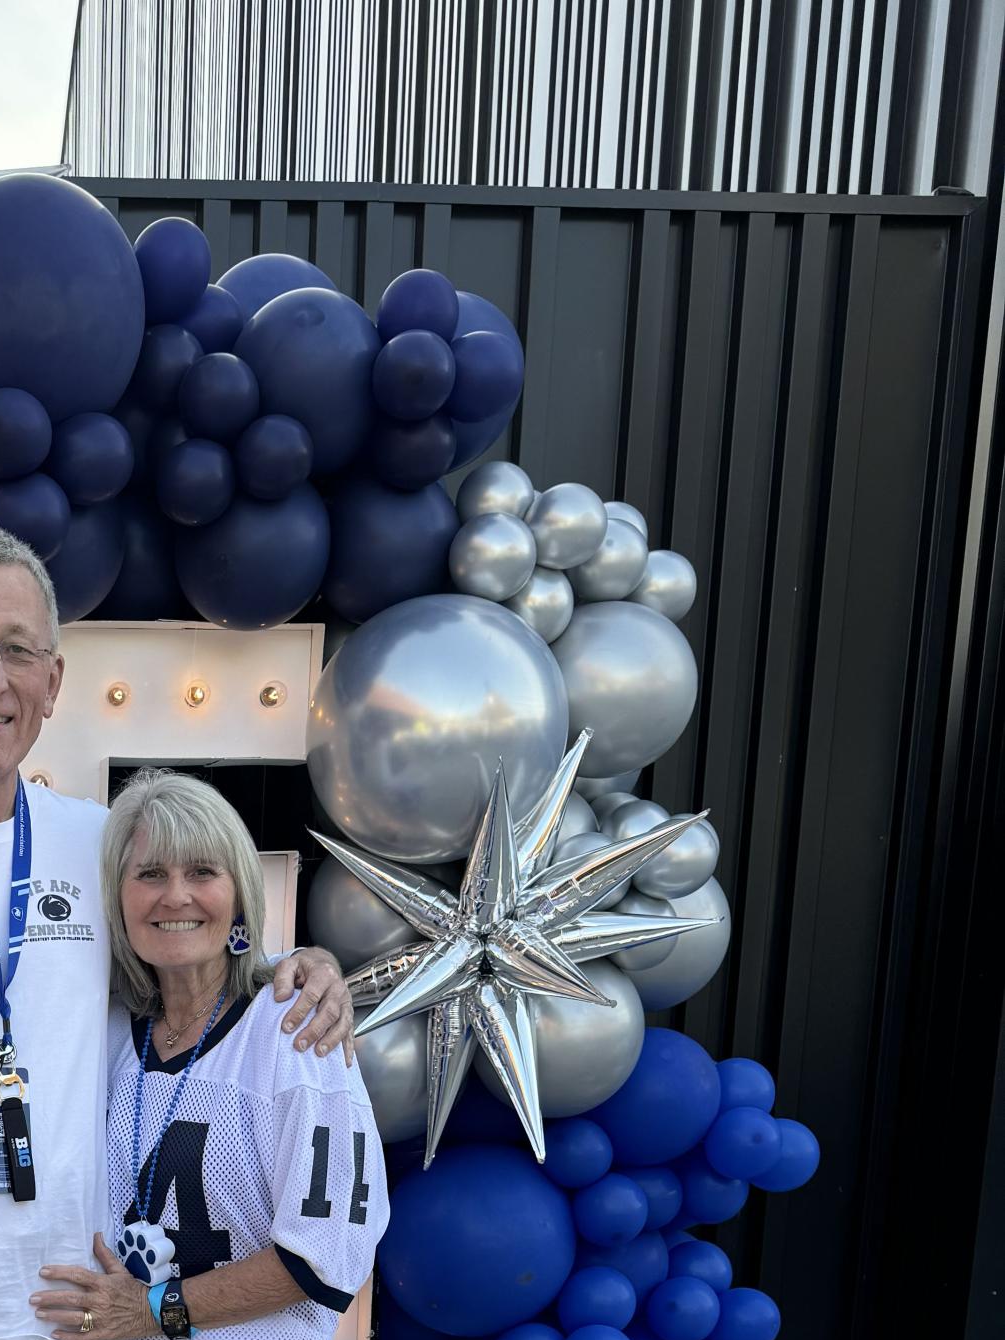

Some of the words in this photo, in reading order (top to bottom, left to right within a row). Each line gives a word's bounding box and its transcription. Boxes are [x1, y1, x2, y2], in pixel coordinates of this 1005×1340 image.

[29, 880, 45, 897] E
[50, 879, 82, 901] ARE
[25, 924, 56, 937] ENN
[56, 923, 95, 937] STATE
